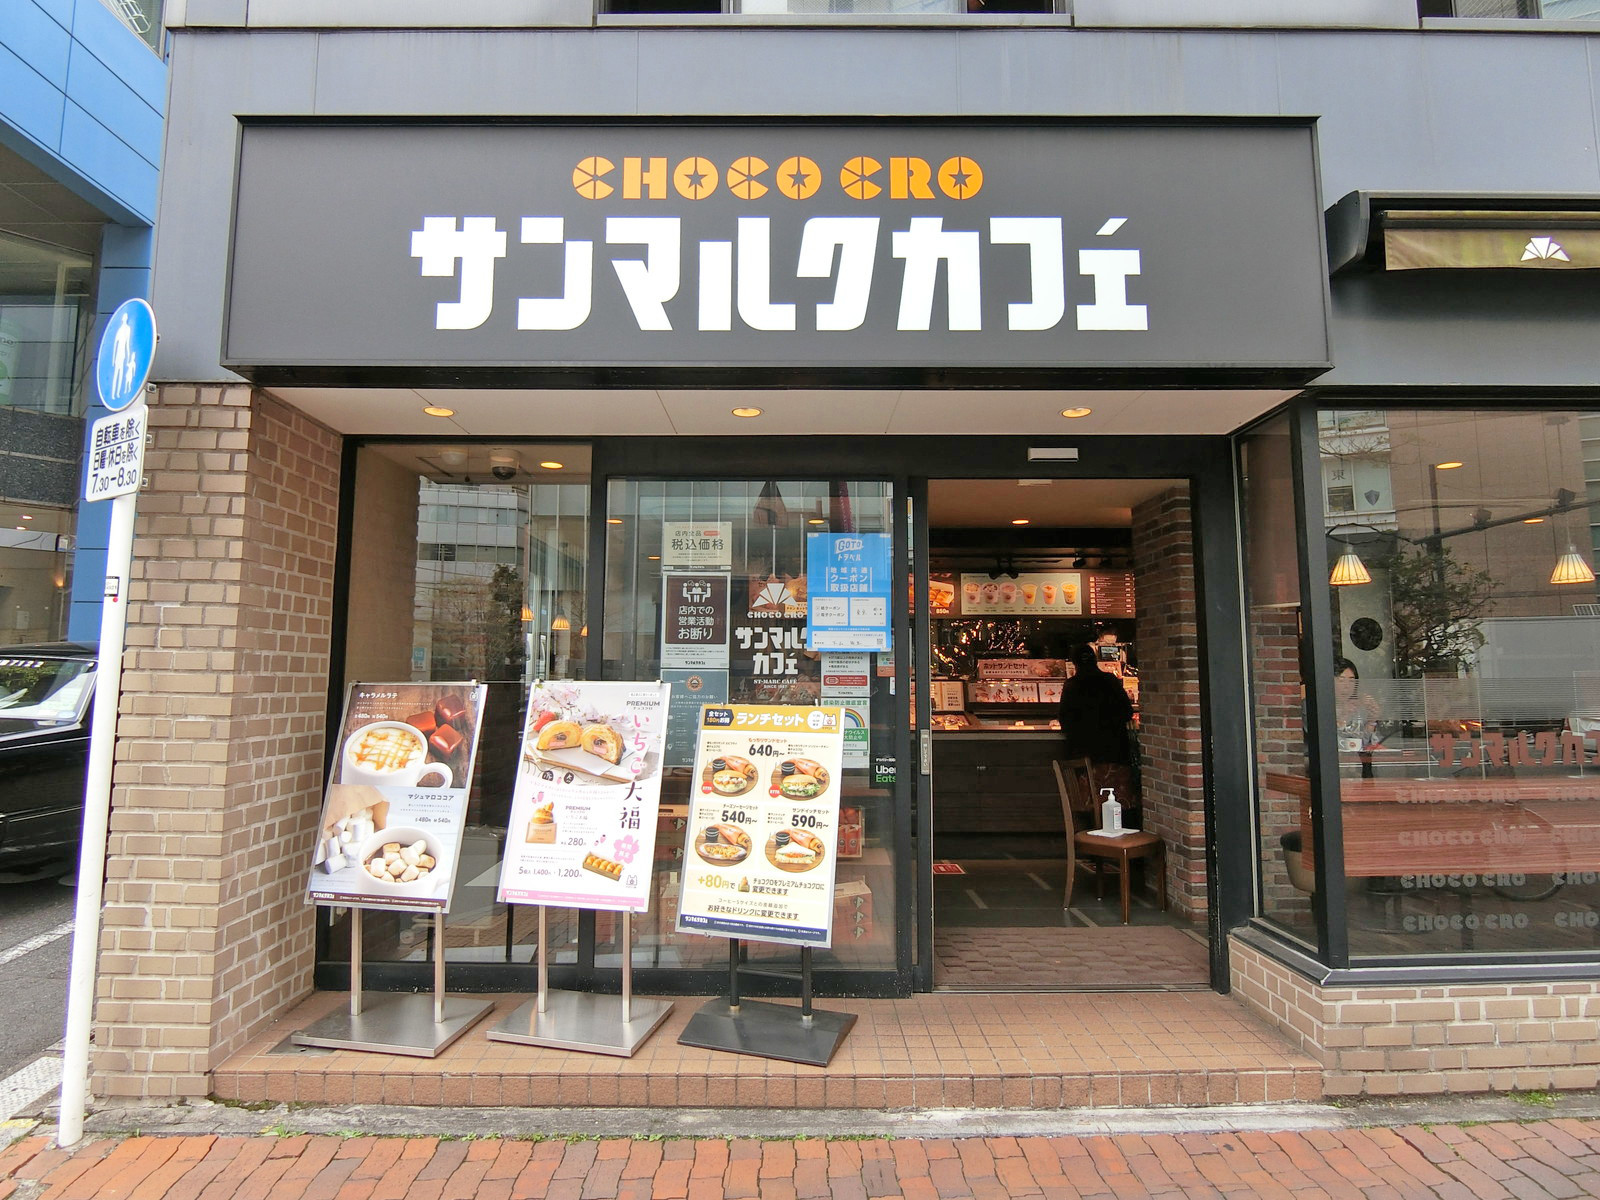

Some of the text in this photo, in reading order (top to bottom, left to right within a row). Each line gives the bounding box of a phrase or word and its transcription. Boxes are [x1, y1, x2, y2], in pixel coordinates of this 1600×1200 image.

[573, 156, 985, 201] CHOCO CRO
[411, 217, 1148, 331] サンマルクカフェ
[96, 418, 140, 447] 自転車を除く
[672, 538, 724, 550] 税込価格
[830, 575, 868, 583] クーポン
[830, 583, 868, 592] 取扱店舗
[679, 606, 714, 615] 店内での
[747, 611, 804, 619] CHOCO CRO
[678, 616, 715, 626] 営業活動
[678, 627, 713, 640] お断り
[753, 652, 798, 675] カフェ
[736, 712, 804, 727] ランチセット
[619, 714, 651, 829] いちご大福
[1399, 828, 1525, 847] CHOCO CRO
[753, 877, 825, 890] チョコクロをプレミアムチョコクロに
[1401, 872, 1526, 889] CHOCO CRO
[1552, 872, 1600, 885] CHO
[752, 885, 789, 895] 変更できます
[707, 904, 799, 920] お好きなドリンクに変更できます
[1403, 913, 1529, 931] CHOCO CRO
